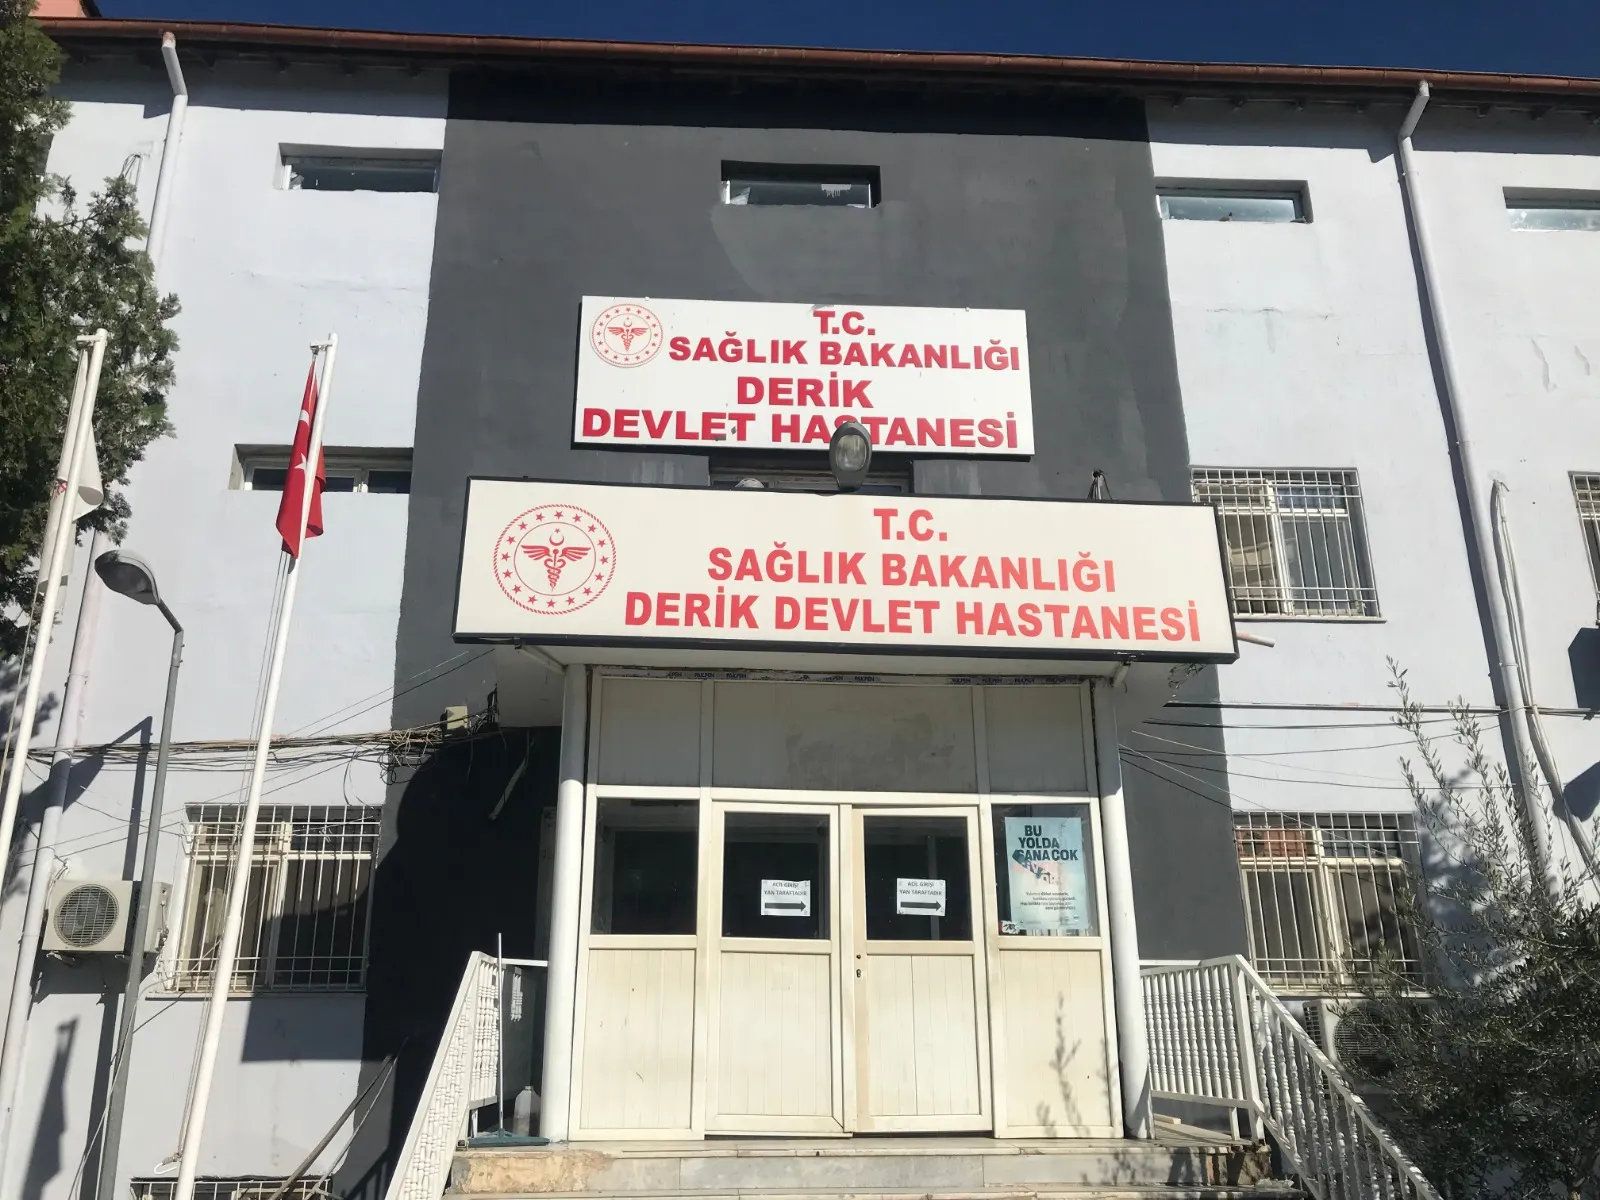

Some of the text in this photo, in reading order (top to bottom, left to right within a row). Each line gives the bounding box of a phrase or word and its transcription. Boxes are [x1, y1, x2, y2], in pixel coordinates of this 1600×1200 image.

[813, 310, 876, 336] T.C.
[668, 331, 1020, 371] SAĞLIK BAKANLIĞI
[737, 371, 873, 409] DERİK
[582, 408, 757, 442] DEVLET
[872, 507, 948, 542] T.C.
[707, 541, 1116, 593] SAĞLIK BAKANLIĞI
[624, 585, 1201, 642] DERİK DEVLET HASTANESİ
[1018, 837, 1060, 849] YOLDA
[1024, 825, 1042, 837] BU
